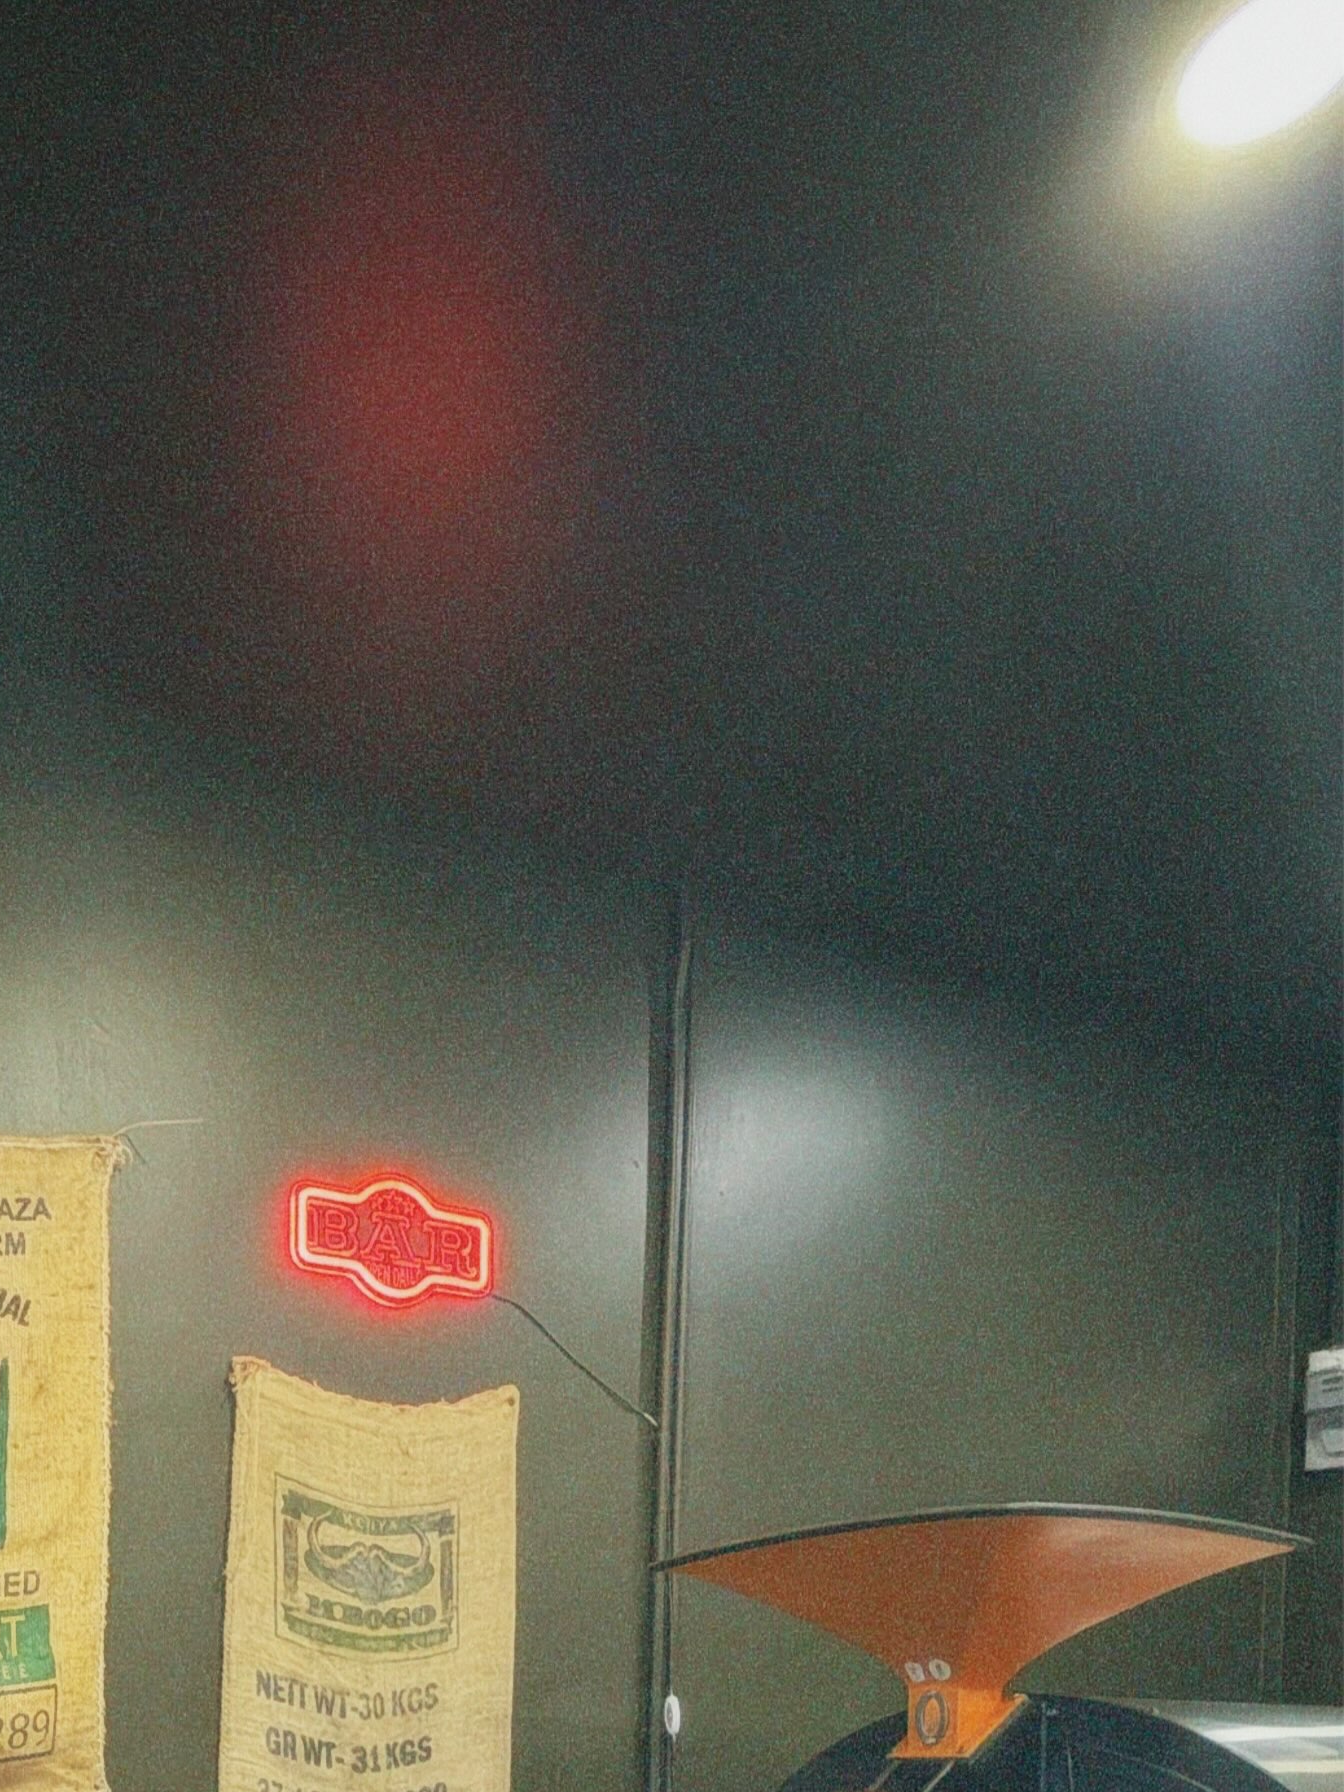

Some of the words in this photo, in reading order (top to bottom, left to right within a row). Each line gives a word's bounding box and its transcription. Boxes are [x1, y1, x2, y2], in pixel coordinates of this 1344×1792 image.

[306, 1199, 478, 1279] BAR
[256, 1669, 308, 1710] NETT
[392, 1682, 439, 1717] KGS
[266, 1726, 298, 1761] GR
[385, 1735, 433, 1771] KGS
